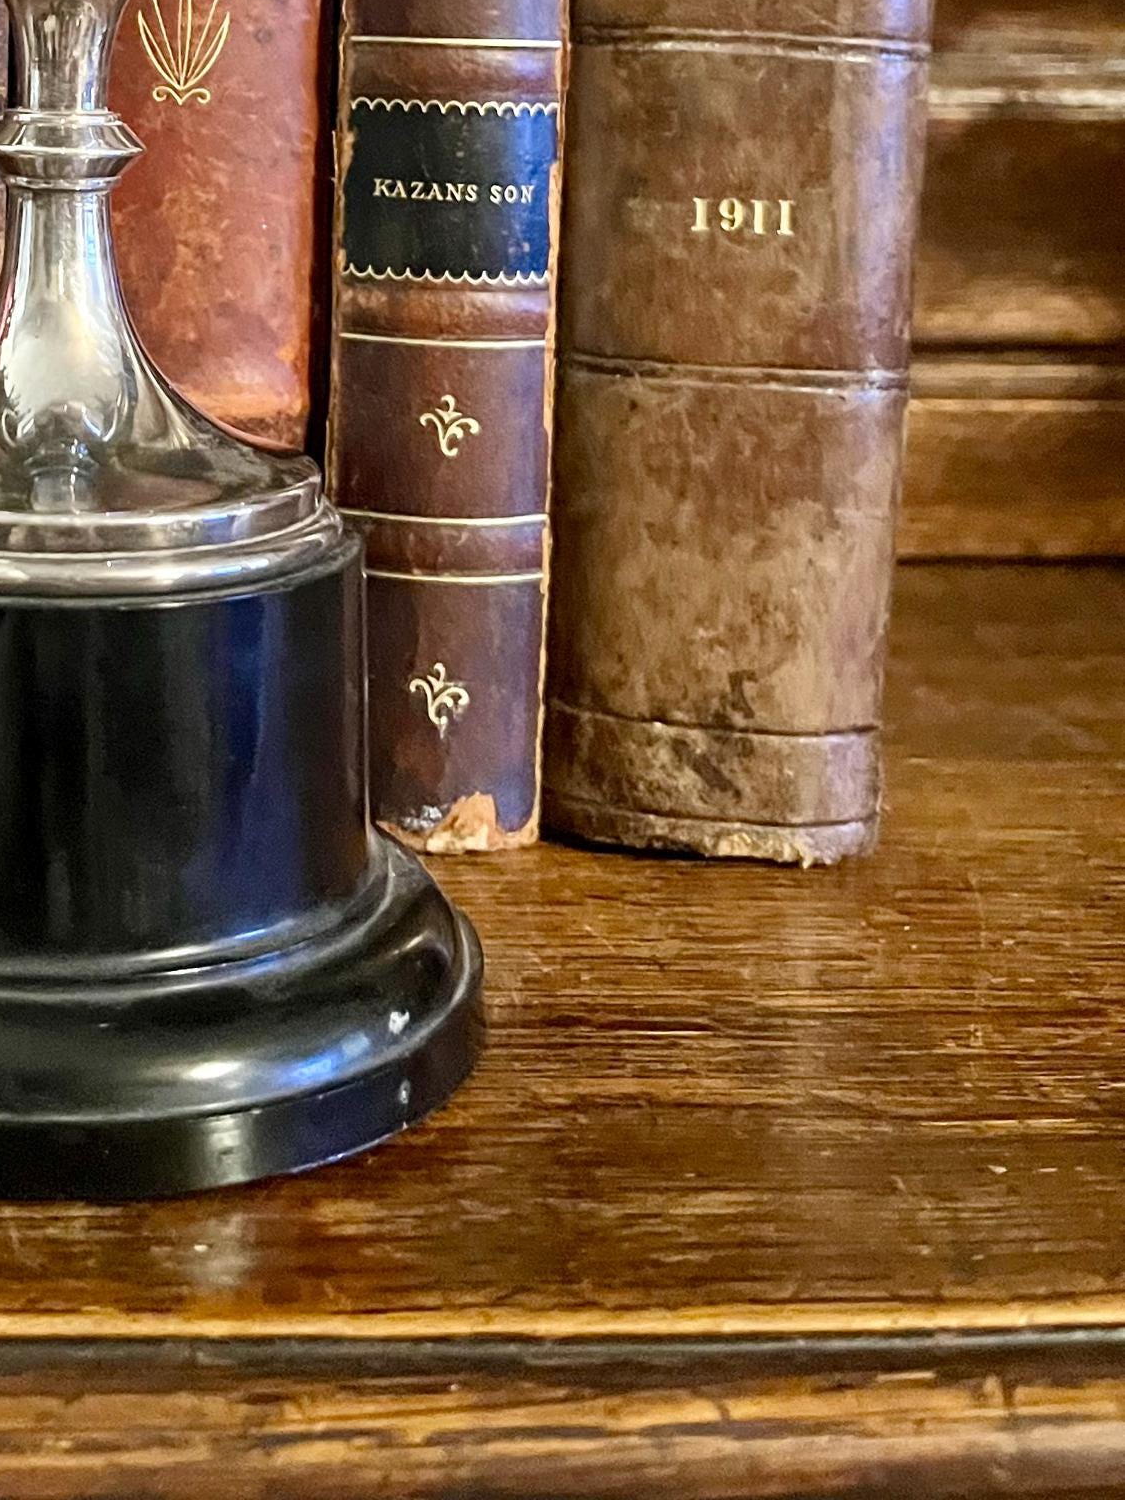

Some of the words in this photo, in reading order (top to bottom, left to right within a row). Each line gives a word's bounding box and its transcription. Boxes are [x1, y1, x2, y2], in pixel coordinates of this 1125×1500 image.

[372, 177, 478, 203] KAZANS
[490, 183, 536, 204] SON
[690, 197, 795, 236] 1911
